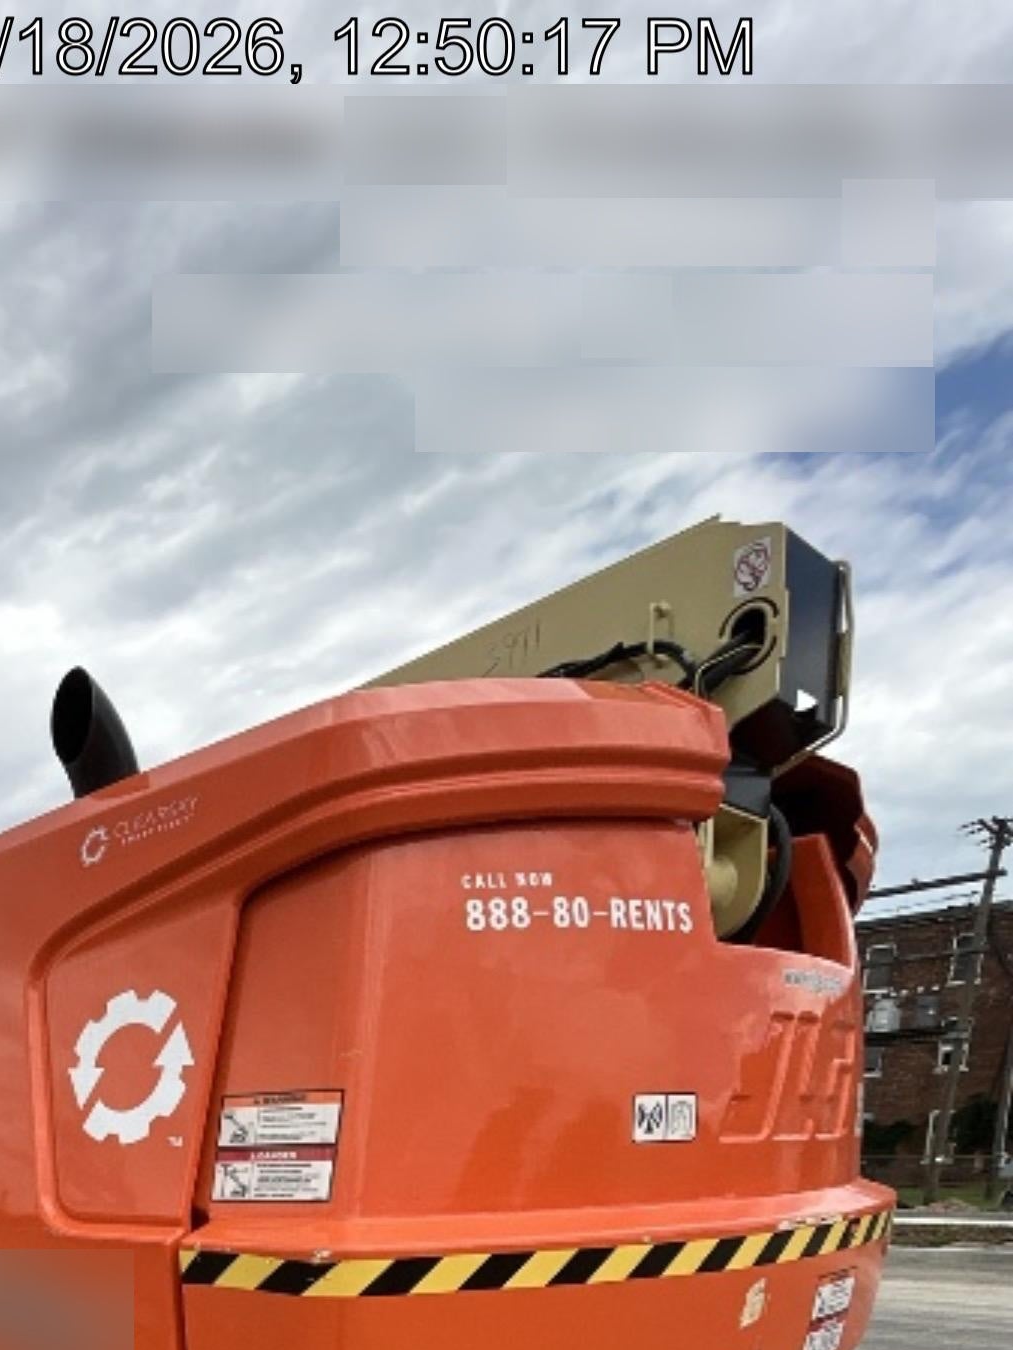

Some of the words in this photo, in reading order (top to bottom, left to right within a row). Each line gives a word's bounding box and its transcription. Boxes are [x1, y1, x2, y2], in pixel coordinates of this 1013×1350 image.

[460, 872, 507, 889] CALL
[514, 872, 553, 887] NOW
[466, 896, 693, 934] 888-80-RENTS
